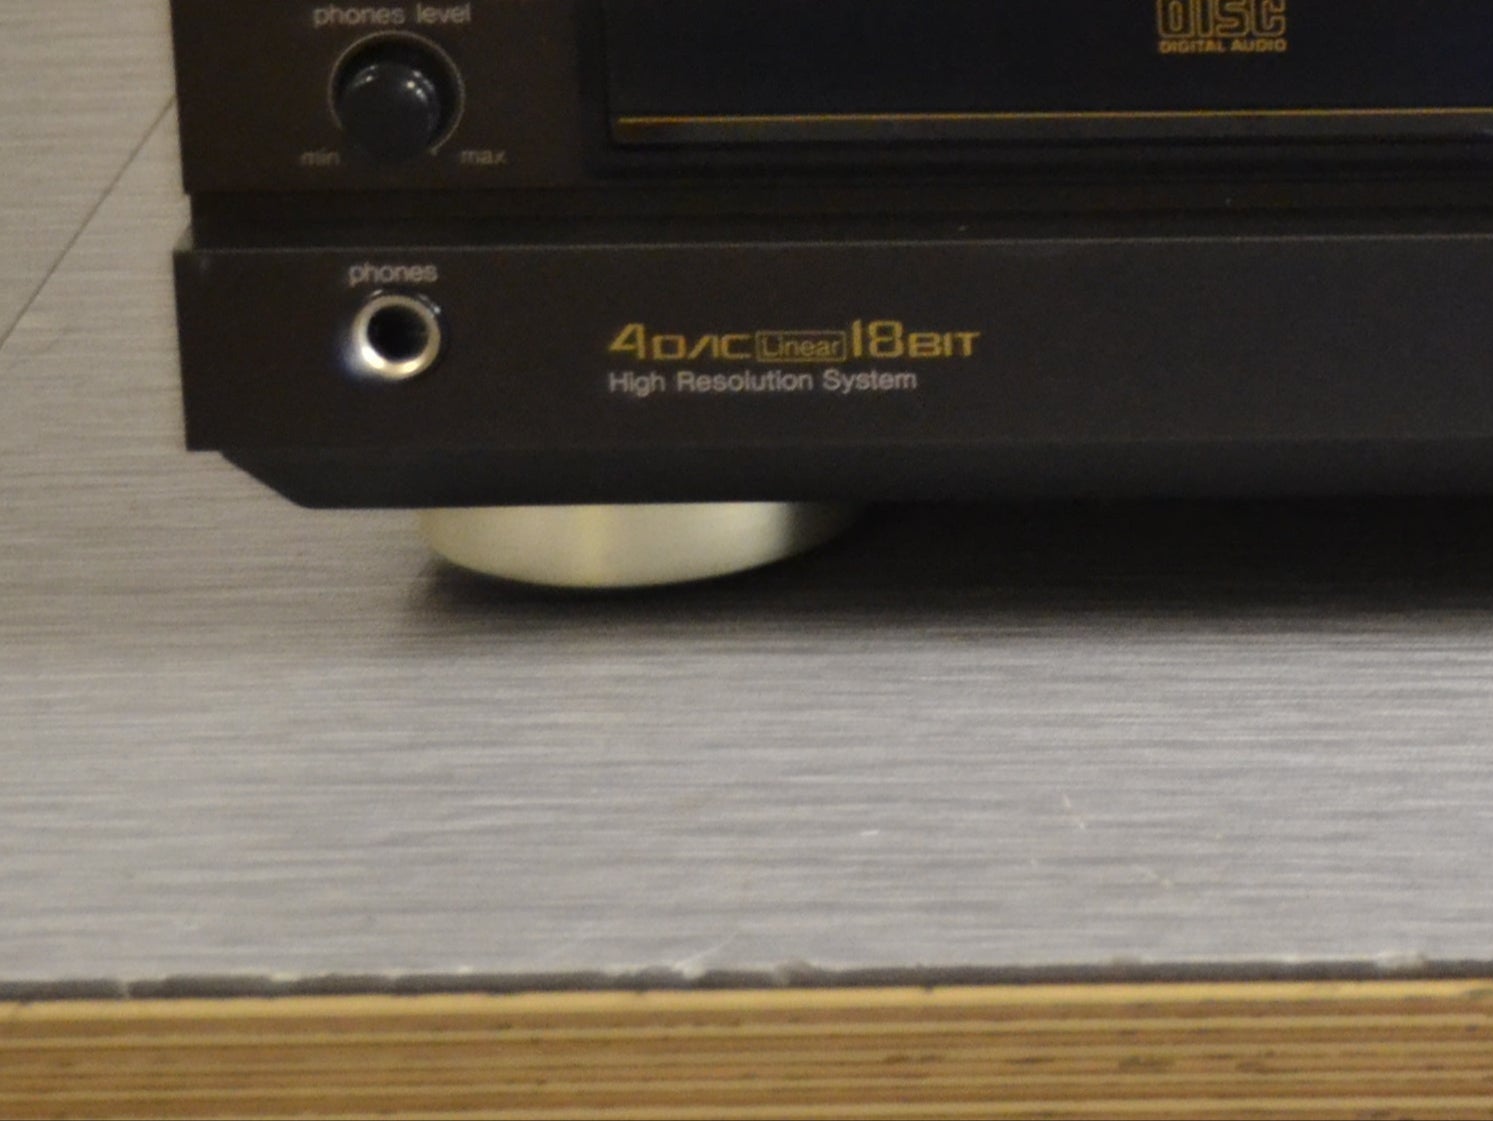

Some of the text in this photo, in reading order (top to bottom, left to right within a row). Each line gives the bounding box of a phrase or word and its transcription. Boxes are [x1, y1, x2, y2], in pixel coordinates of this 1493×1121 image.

[313, 3, 471, 27] phones level
[1159, 39, 1287, 53] DIGITAL AUDIO
[301, 149, 340, 165] min
[460, 148, 506, 164] max
[349, 263, 438, 286] phones
[761, 335, 841, 358] Linear
[609, 368, 918, 398] High Resolution System
